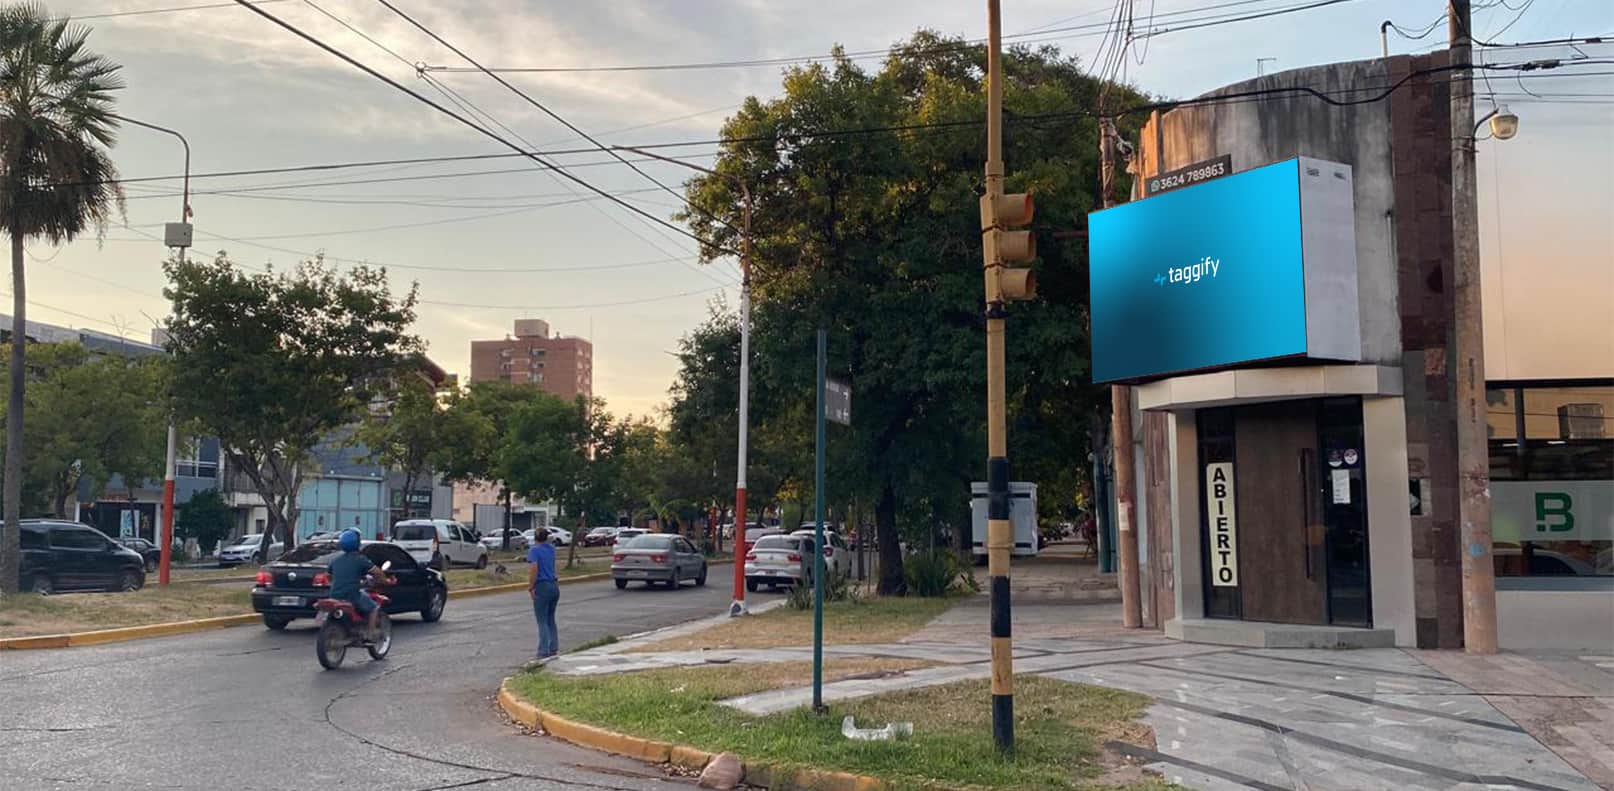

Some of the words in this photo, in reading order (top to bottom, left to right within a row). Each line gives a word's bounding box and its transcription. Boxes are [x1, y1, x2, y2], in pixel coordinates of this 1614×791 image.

[1160, 174, 1185, 190] 3624
[1186, 163, 1224, 183] 789863
[1168, 256, 1220, 284] taggify
[1213, 467, 1233, 583] ABIERTO
[1535, 492, 1575, 532] B
